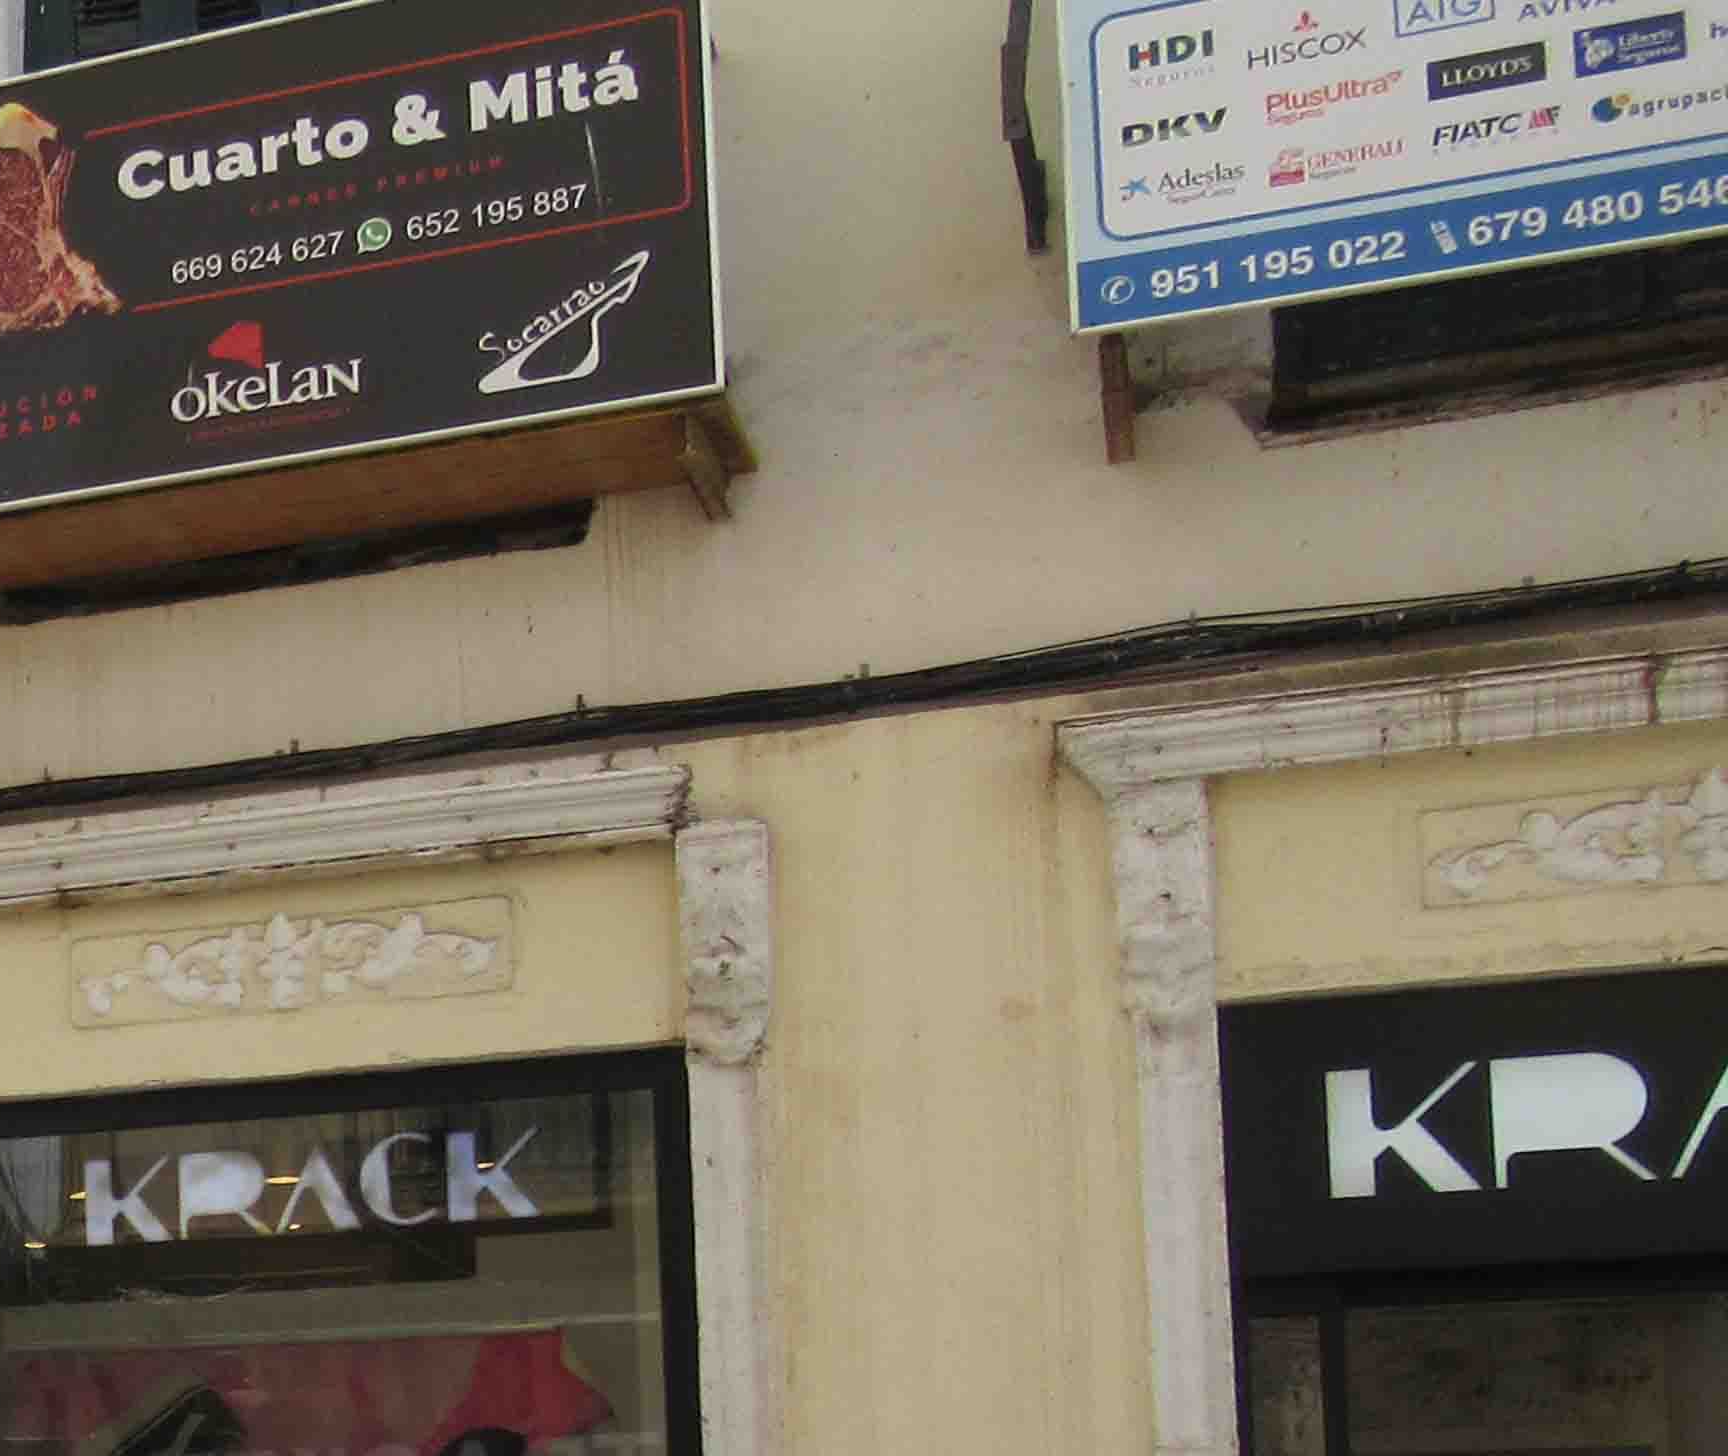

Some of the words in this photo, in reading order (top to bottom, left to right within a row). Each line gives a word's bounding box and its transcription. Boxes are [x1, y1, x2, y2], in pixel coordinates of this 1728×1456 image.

[1129, 30, 1214, 71] HDI
[1248, 26, 1367, 70] HISCOX
[118, 117, 369, 200] Cuarto
[392, 94, 446, 145] &
[470, 49, 639, 132] Mitá
[1122, 107, 1227, 148] DKV
[1432, 112, 1522, 146] FIATC
[1158, 161, 1246, 192] Adeslas
[172, 254, 222, 284] 669
[231, 242, 283, 273] 624
[291, 230, 344, 262] 627
[406, 208, 460, 240] 652
[471, 196, 523, 228] 195
[533, 184, 587, 216] 887
[1151, 260, 1221, 298] 951
[1240, 245, 1315, 283] 195
[1328, 231, 1407, 269] 022
[1468, 207, 1548, 247] 679
[1562, 191, 1644, 229] 480
[85, 1125, 541, 1247] KRACK
